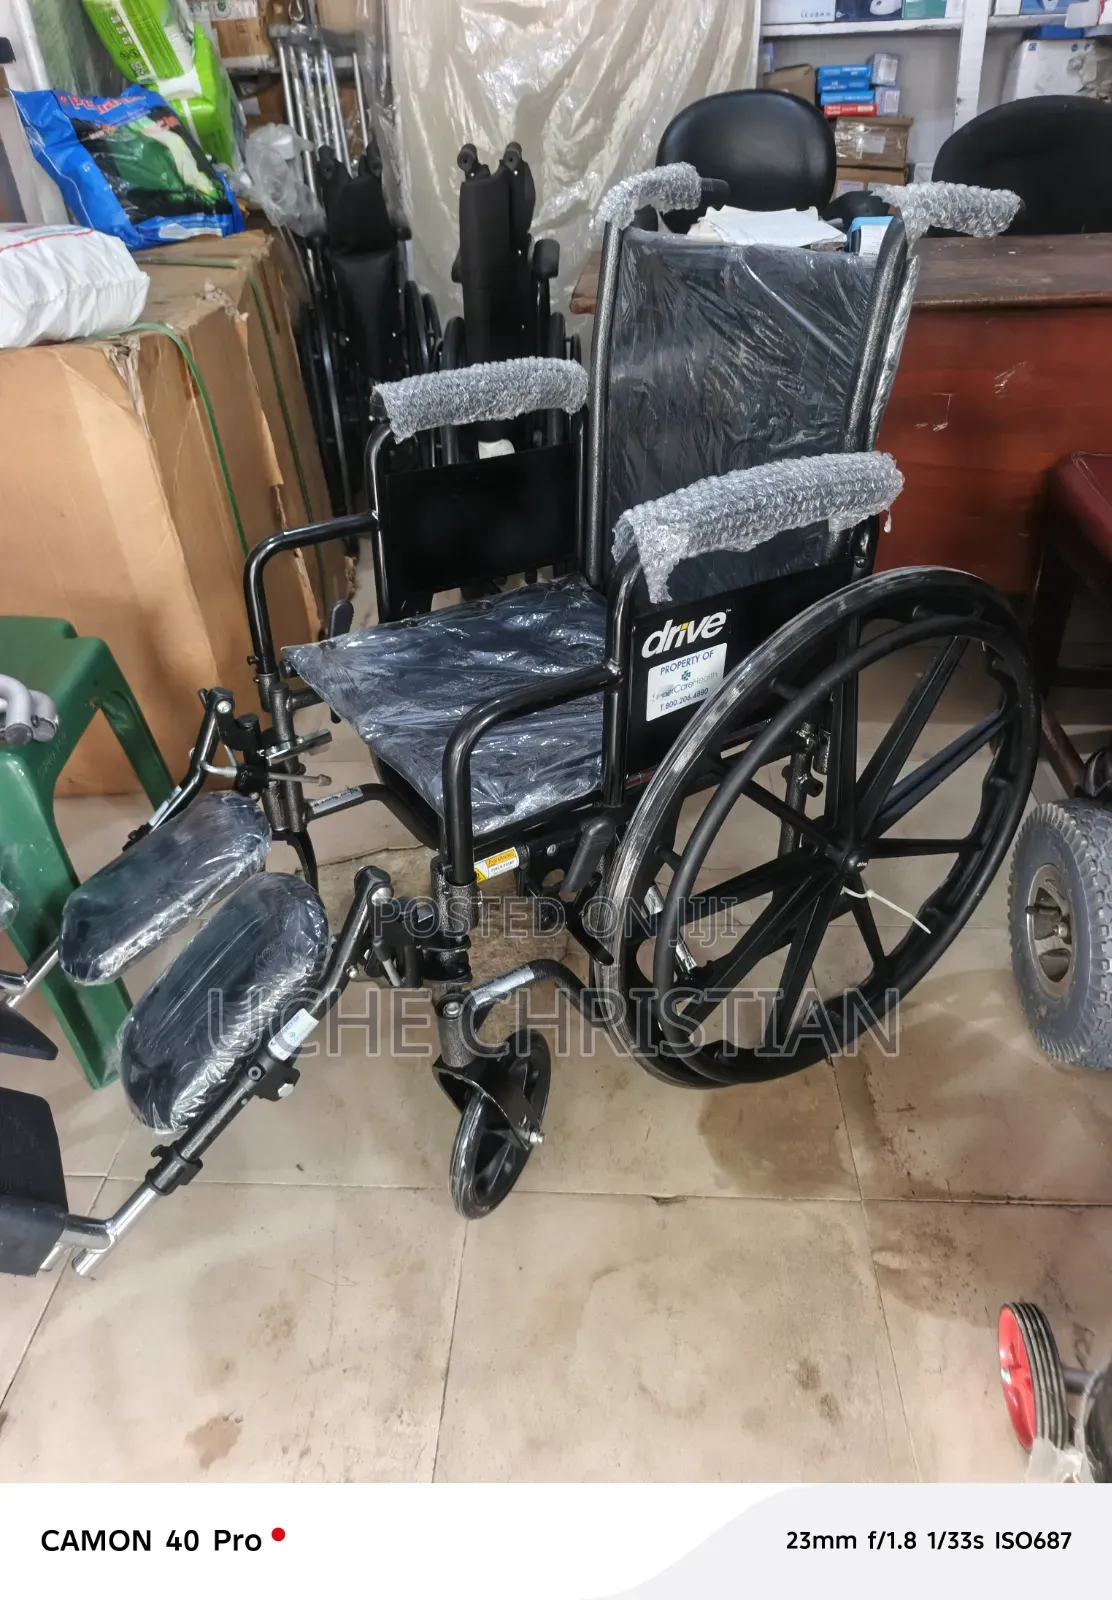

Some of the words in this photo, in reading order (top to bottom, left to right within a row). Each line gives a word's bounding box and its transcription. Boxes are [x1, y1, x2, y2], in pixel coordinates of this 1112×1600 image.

[641, 611, 727, 658] drive
[660, 654, 700, 676] PROPERTY
[702, 649, 714, 661] OF
